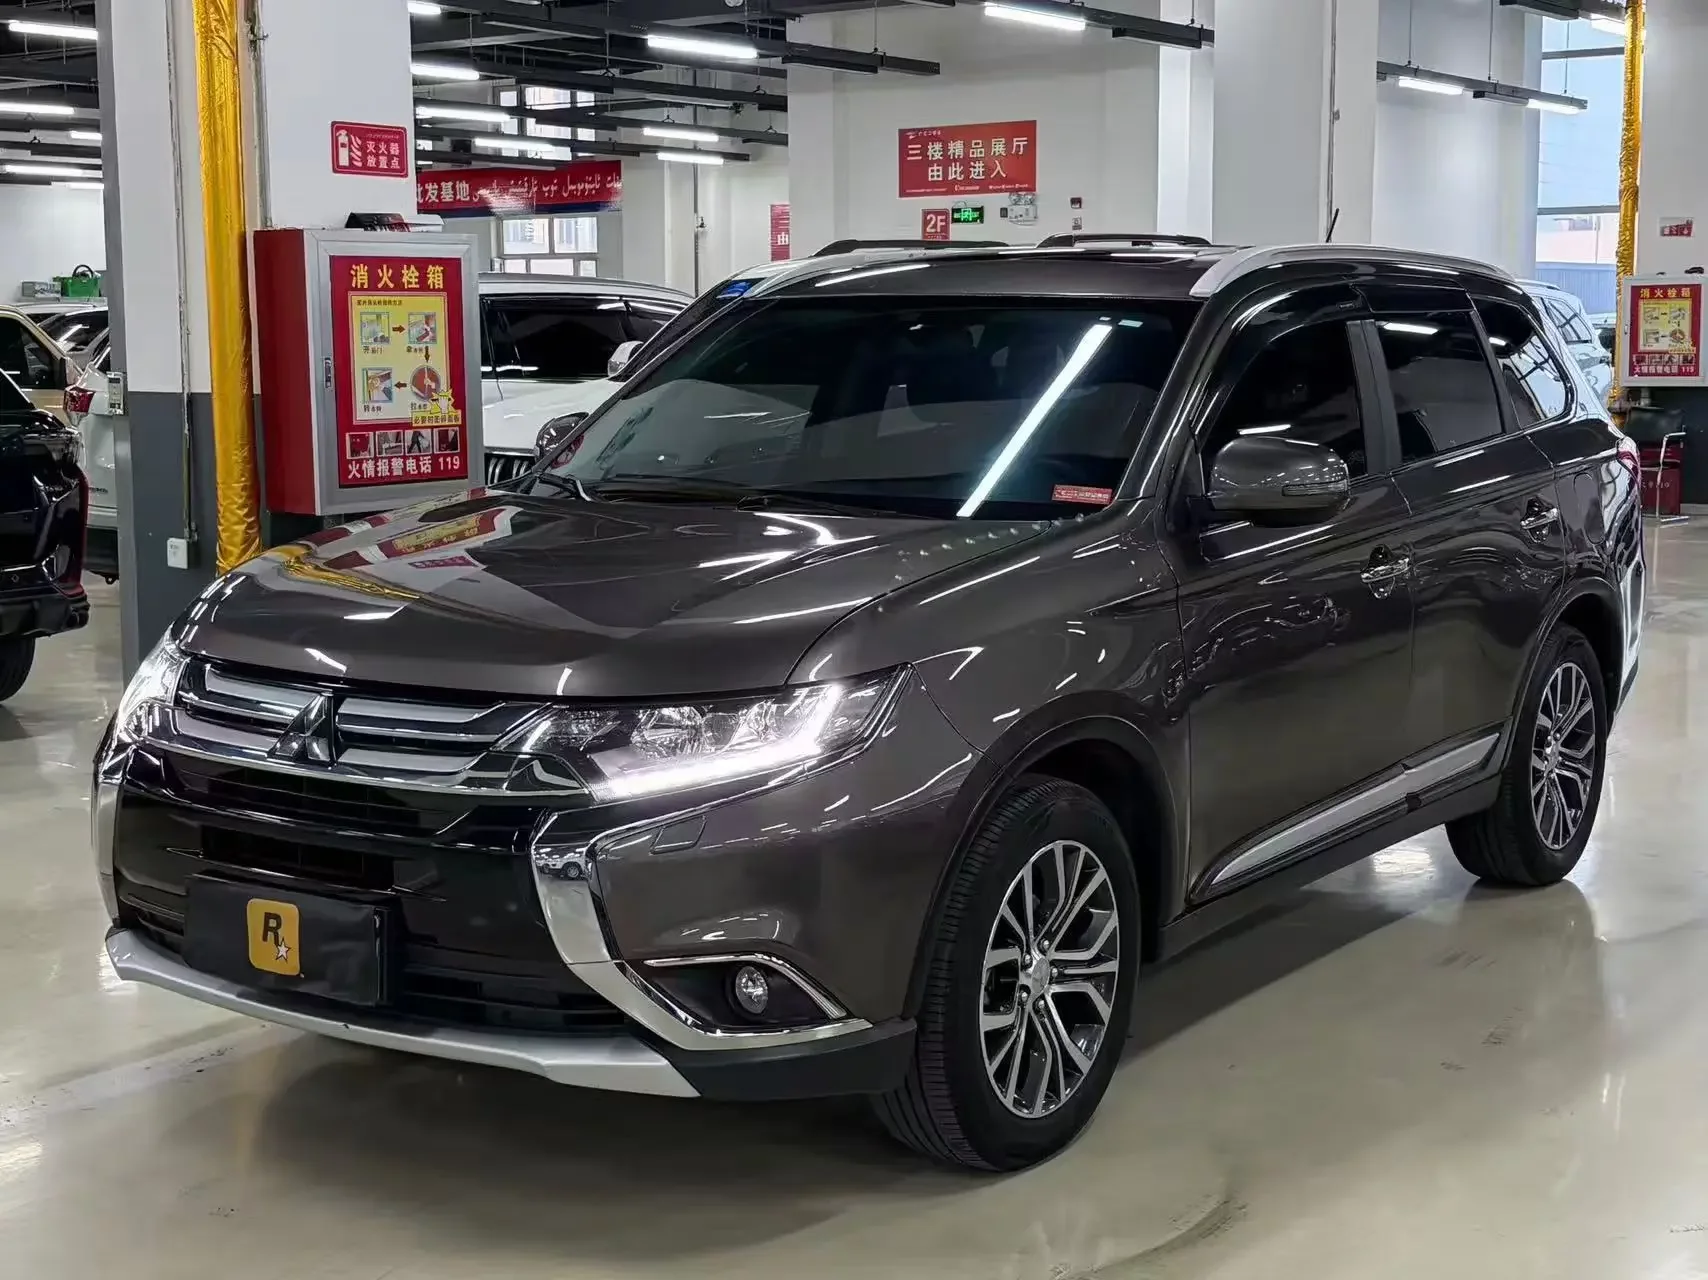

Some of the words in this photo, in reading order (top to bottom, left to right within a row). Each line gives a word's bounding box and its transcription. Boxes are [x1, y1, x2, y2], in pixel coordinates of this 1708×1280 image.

[366, 141, 400, 155] 灭火器
[906, 137, 1028, 160] 三楼精品展厅
[366, 154, 400, 169] 放置点
[928, 160, 1007, 181] 由此进入
[926, 213, 946, 232] 2F
[350, 263, 444, 289] 消火栓箱
[348, 455, 432, 479] 火情报警电话
[438, 456, 460, 471] 119
